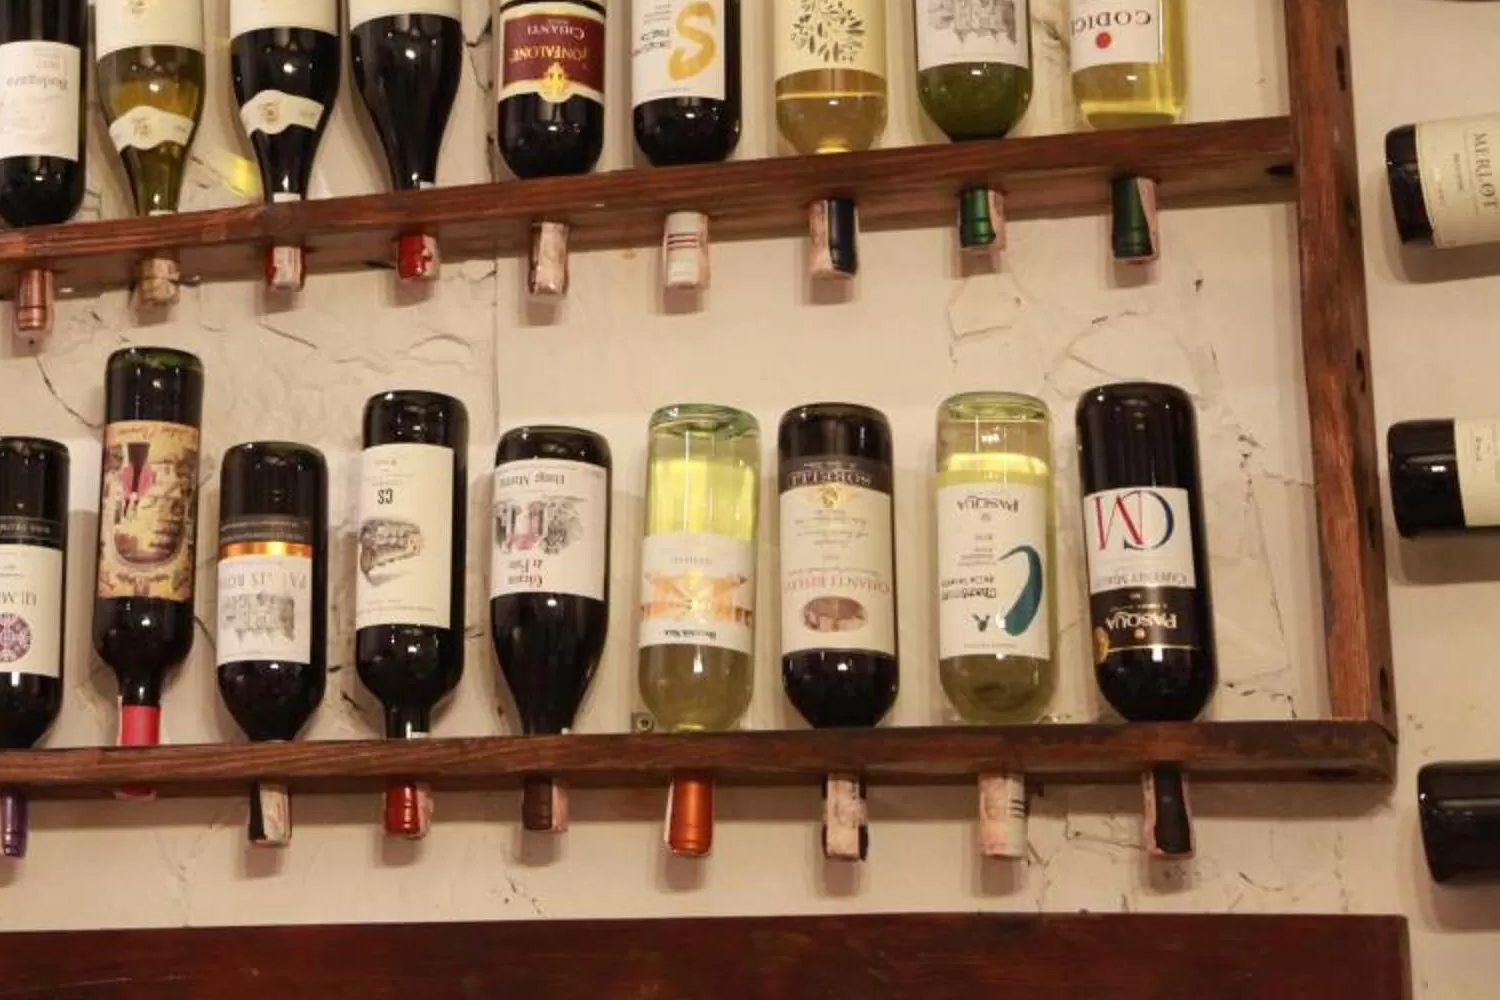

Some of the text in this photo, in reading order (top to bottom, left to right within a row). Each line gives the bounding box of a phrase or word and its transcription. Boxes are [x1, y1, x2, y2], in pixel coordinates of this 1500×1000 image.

[666, 1, 717, 83] S
[1468, 129, 1499, 211] MERLOT
[377, 488, 394, 505] CS
[956, 495, 1020, 516] PASQUA
[1104, 611, 1178, 630] PASQUA
